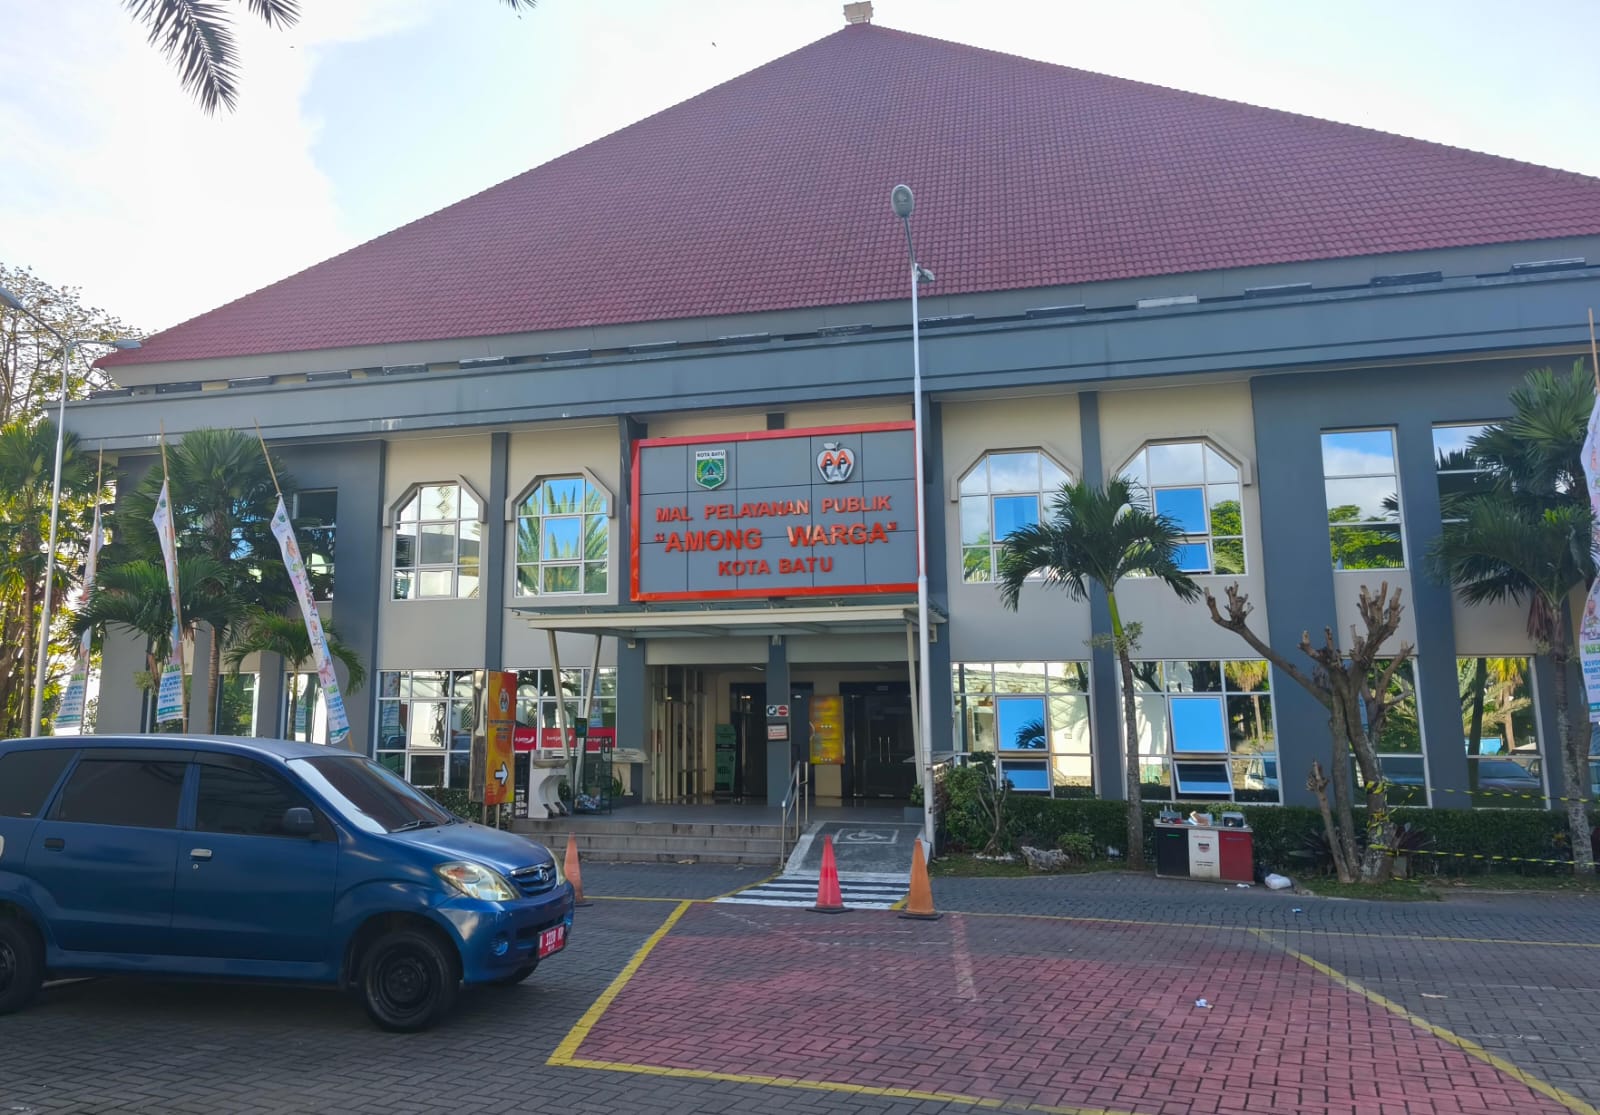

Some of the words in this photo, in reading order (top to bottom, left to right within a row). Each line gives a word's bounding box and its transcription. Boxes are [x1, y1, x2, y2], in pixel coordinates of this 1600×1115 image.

[656, 505, 693, 522] MAL
[704, 499, 809, 520] PELAYANAN
[821, 495, 891, 513] PUBLIK
[654, 528, 763, 553] “AMONG
[786, 521, 897, 547] WARGA”
[718, 559, 771, 576] KOTA
[778, 556, 833, 574] BATU
